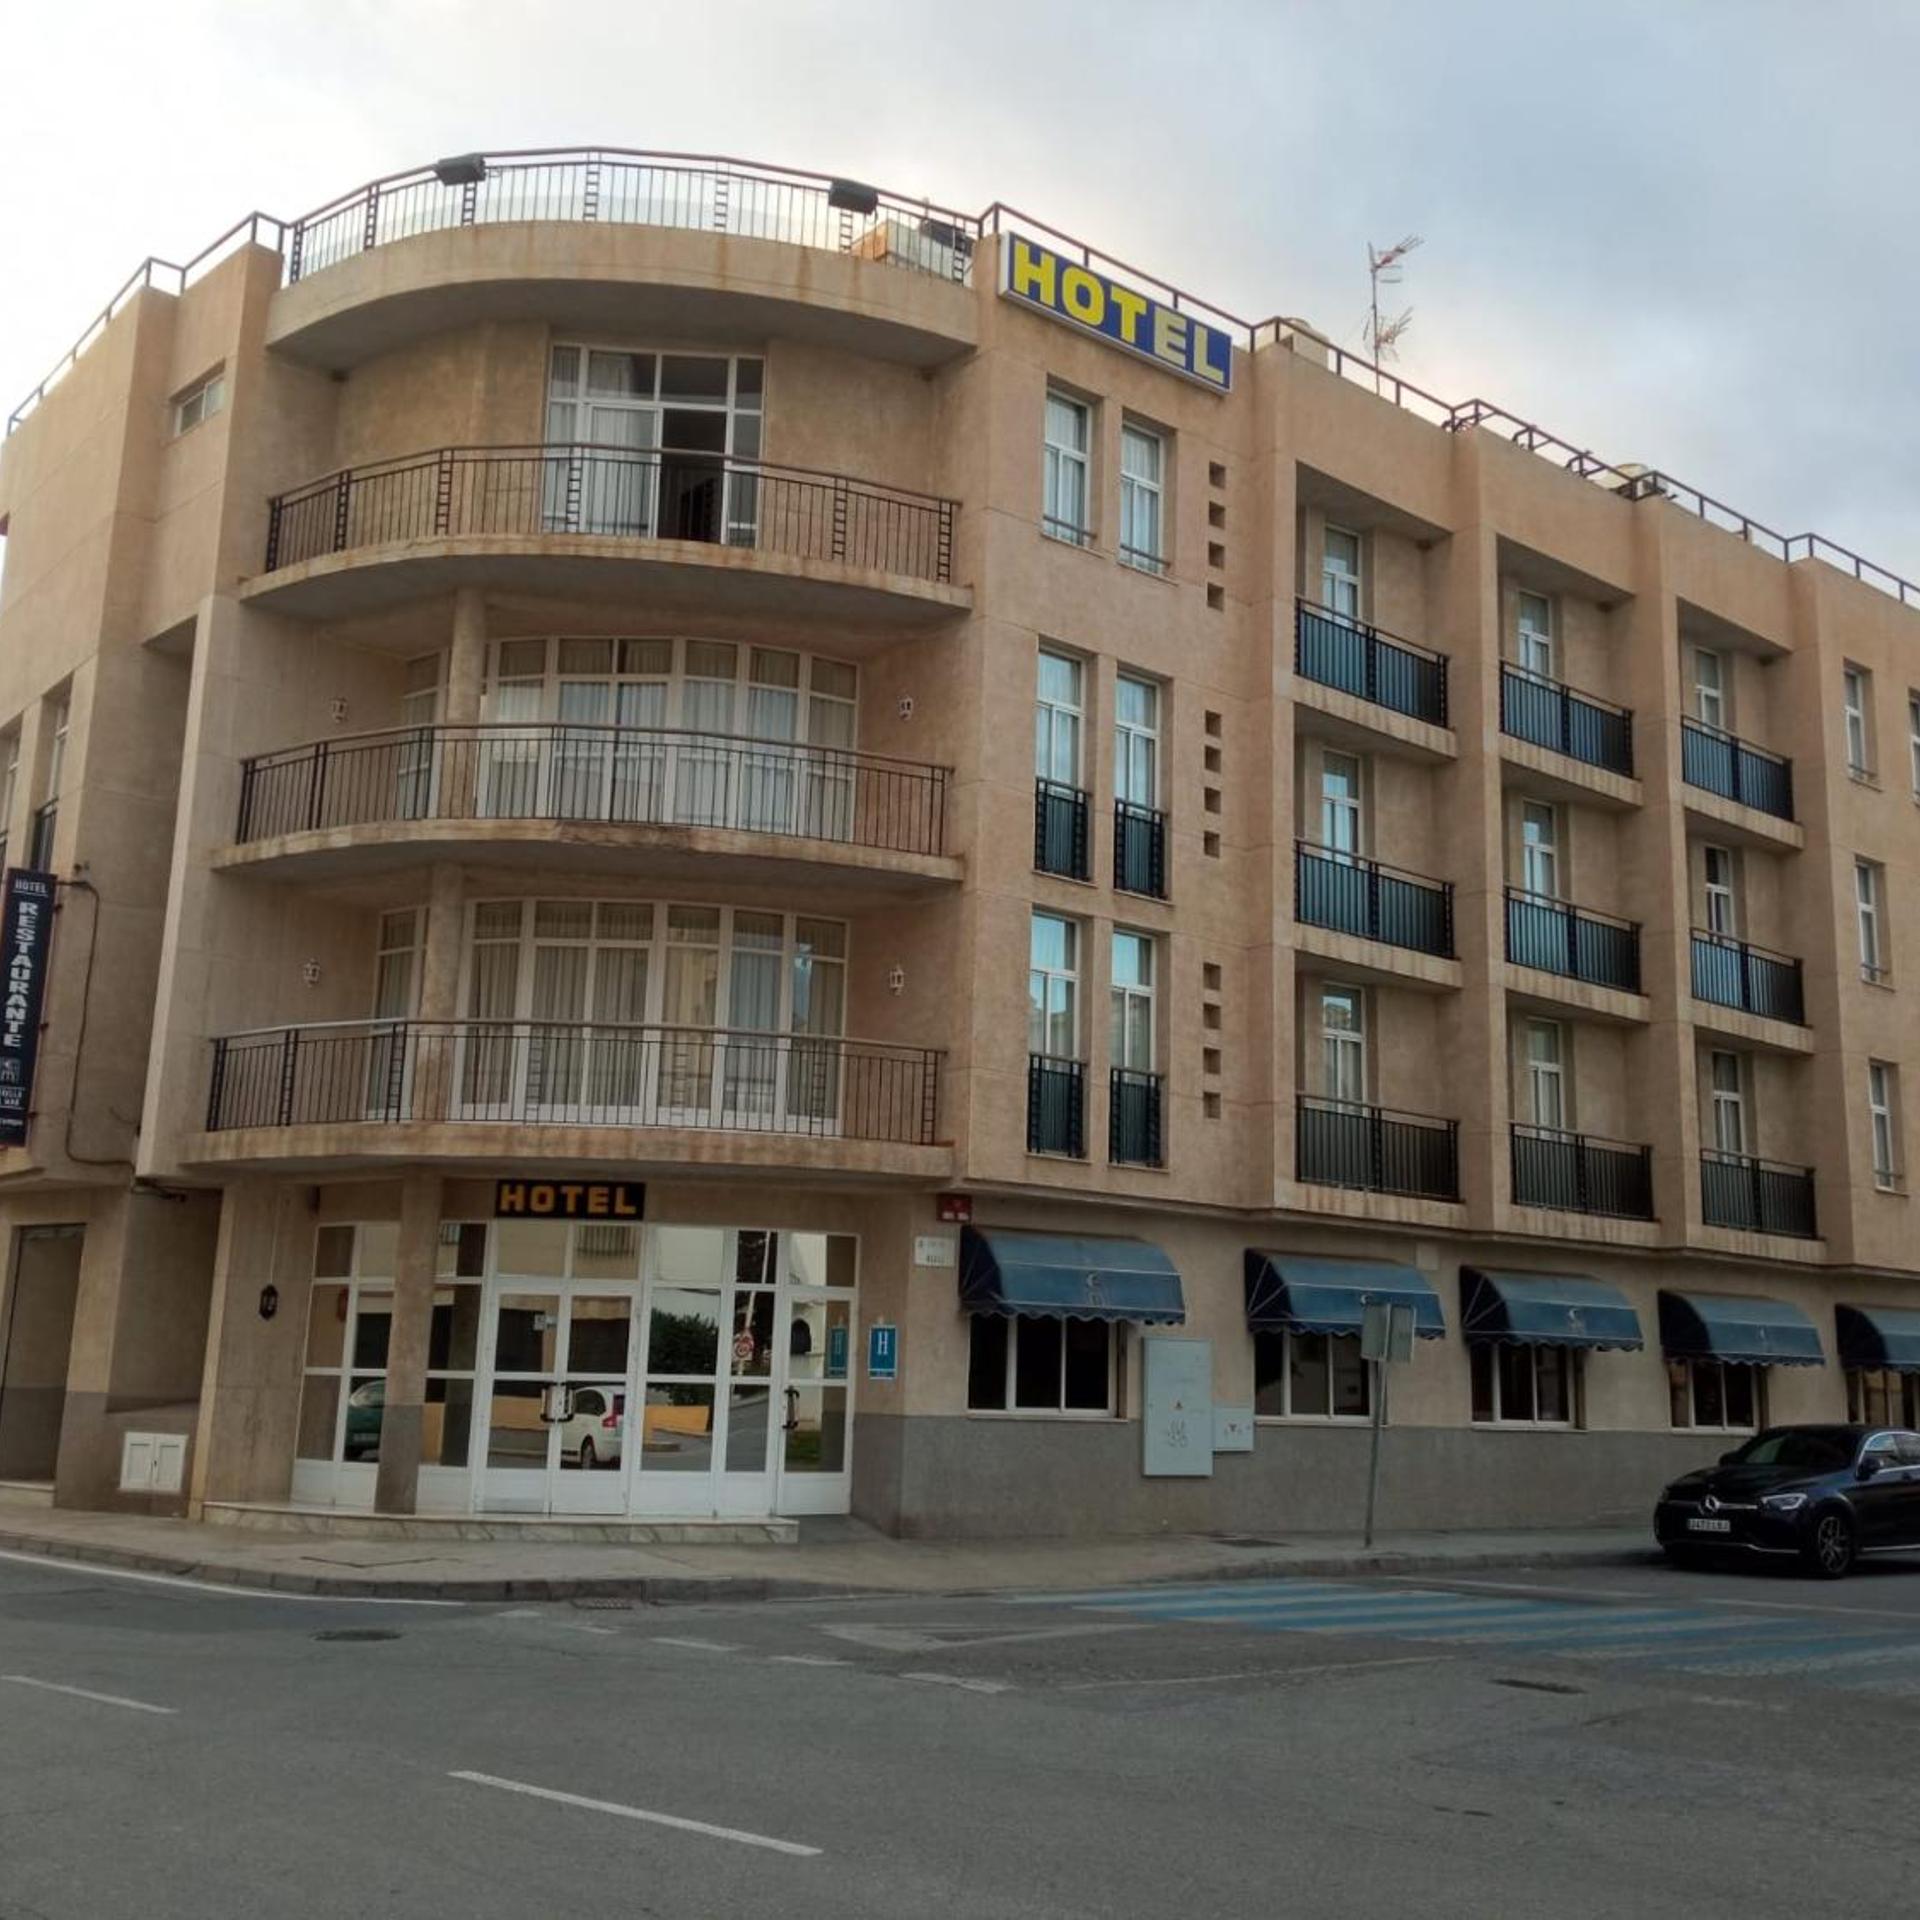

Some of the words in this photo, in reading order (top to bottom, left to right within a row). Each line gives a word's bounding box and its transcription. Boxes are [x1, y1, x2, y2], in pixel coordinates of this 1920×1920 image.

[1013, 239, 1225, 385] HOTEL
[15, 879, 46, 893] HOTEL
[3, 901, 38, 1048] RESTAURANTE
[499, 1184, 637, 1215] HOTEL
[877, 1331, 888, 1355] H
